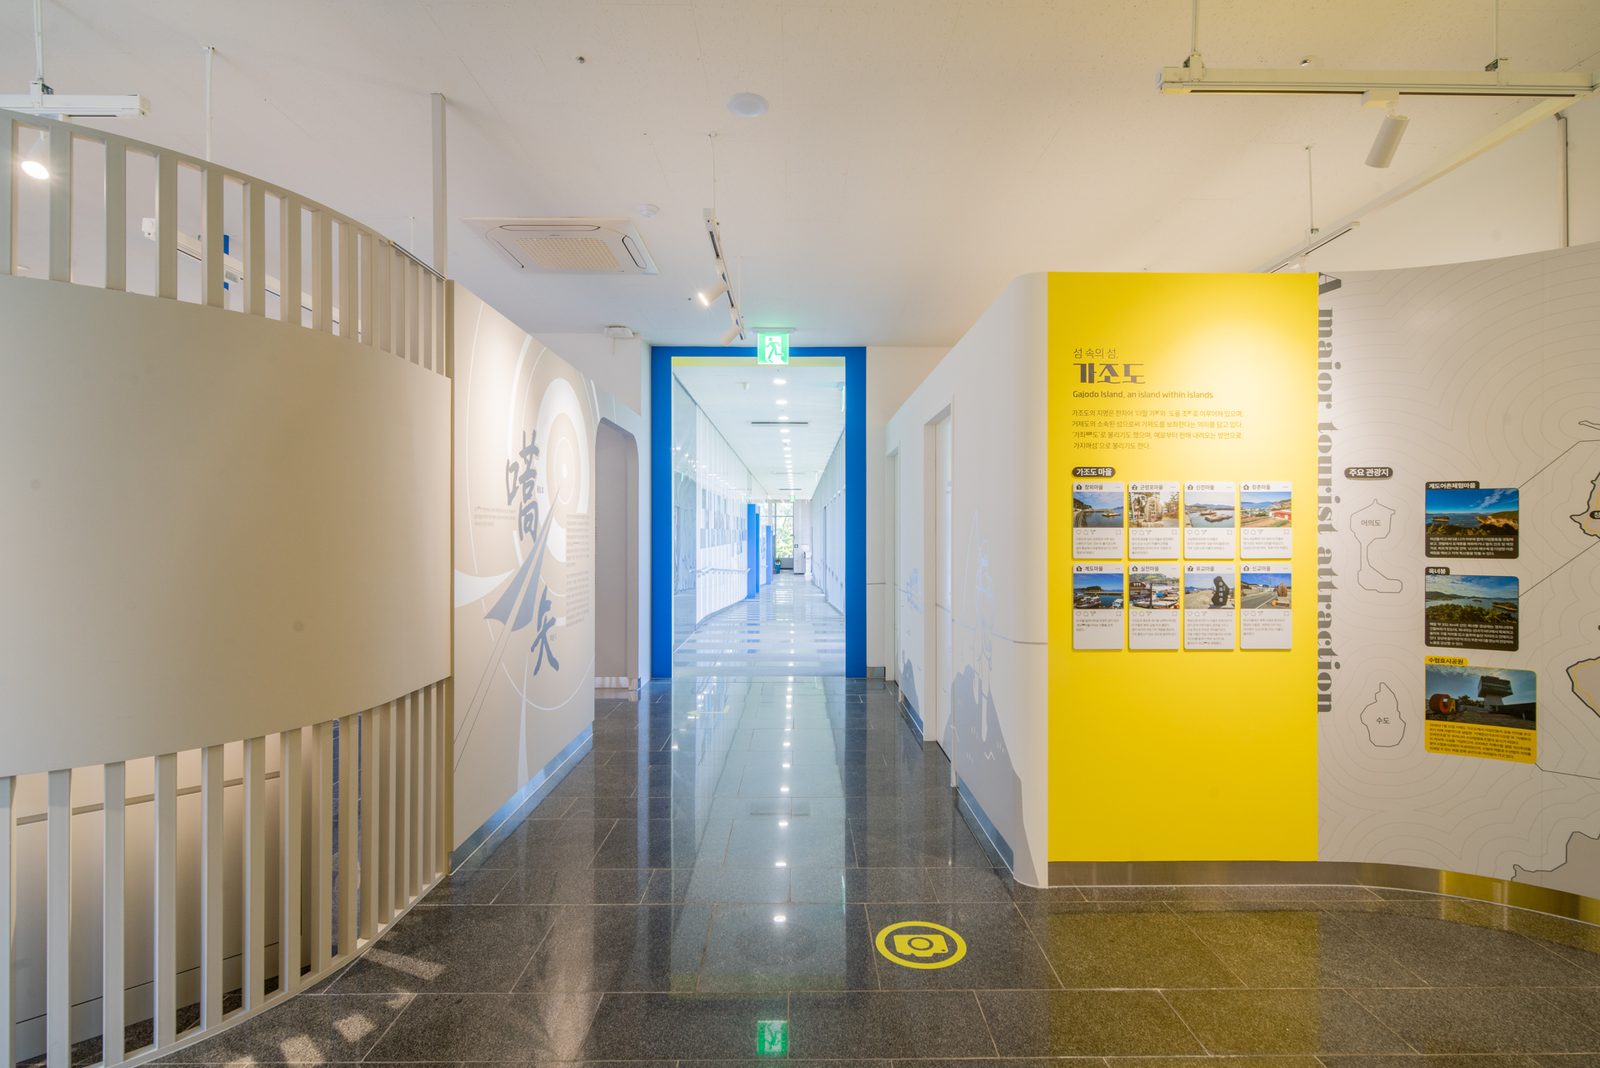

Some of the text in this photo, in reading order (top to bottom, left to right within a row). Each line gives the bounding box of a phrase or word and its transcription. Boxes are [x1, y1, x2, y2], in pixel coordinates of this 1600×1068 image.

[1318, 271, 1342, 295] A
[1073, 348, 1083, 359] 섬
[1085, 348, 1104, 359] 속의
[1073, 363, 1146, 384] 가조도
[1072, 390, 1100, 399] Gajodo
[1138, 390, 1161, 399] island
[1162, 390, 1186, 399] within
[1076, 468, 1113, 477] 가조도 마을
[1349, 468, 1389, 477] 주요 관광지
[1318, 421, 1342, 535] tourist
[1360, 519, 1382, 527] 어의도
[1318, 546, 1341, 713] attraction
[1376, 717, 1390, 725] 수도
